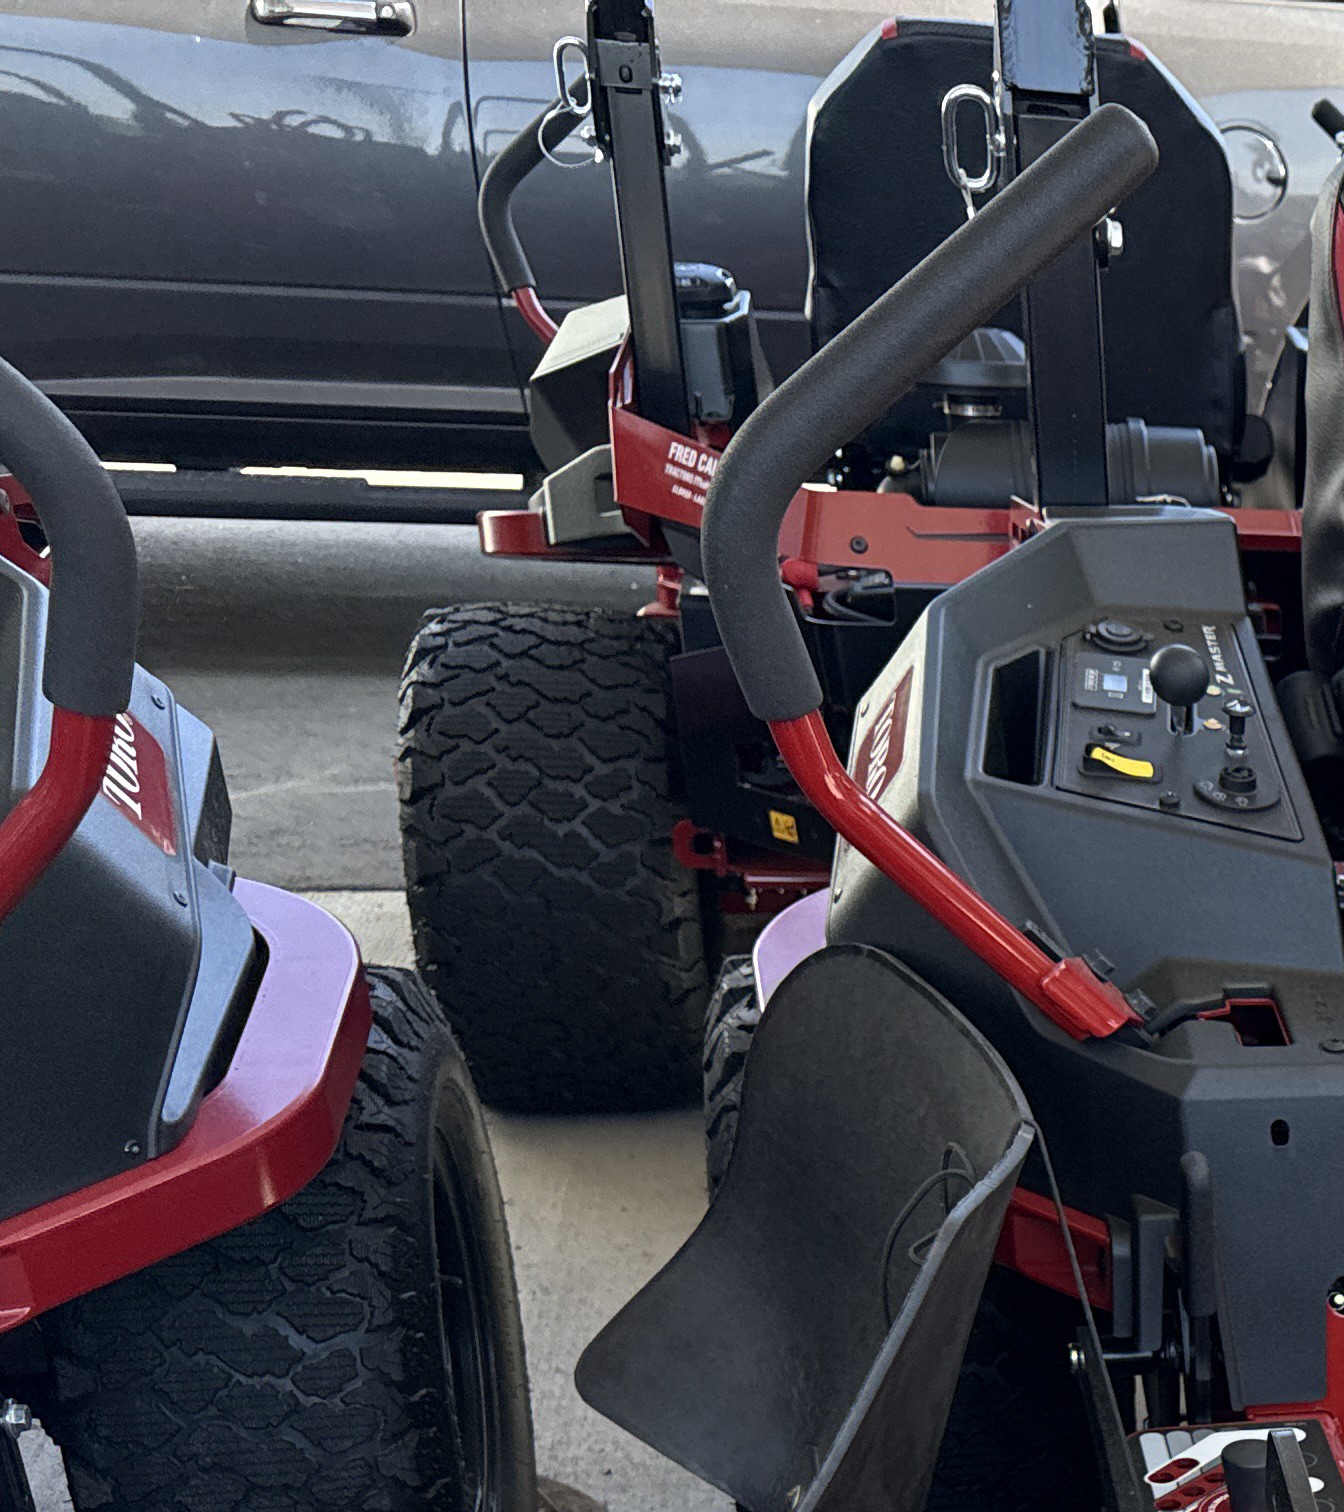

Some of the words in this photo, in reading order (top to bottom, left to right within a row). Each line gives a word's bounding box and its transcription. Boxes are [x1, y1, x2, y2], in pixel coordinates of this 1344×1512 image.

[667, 441, 698, 468] FRED
[1201, 624, 1228, 673] MASTER
[1215, 672, 1235, 686] Z
